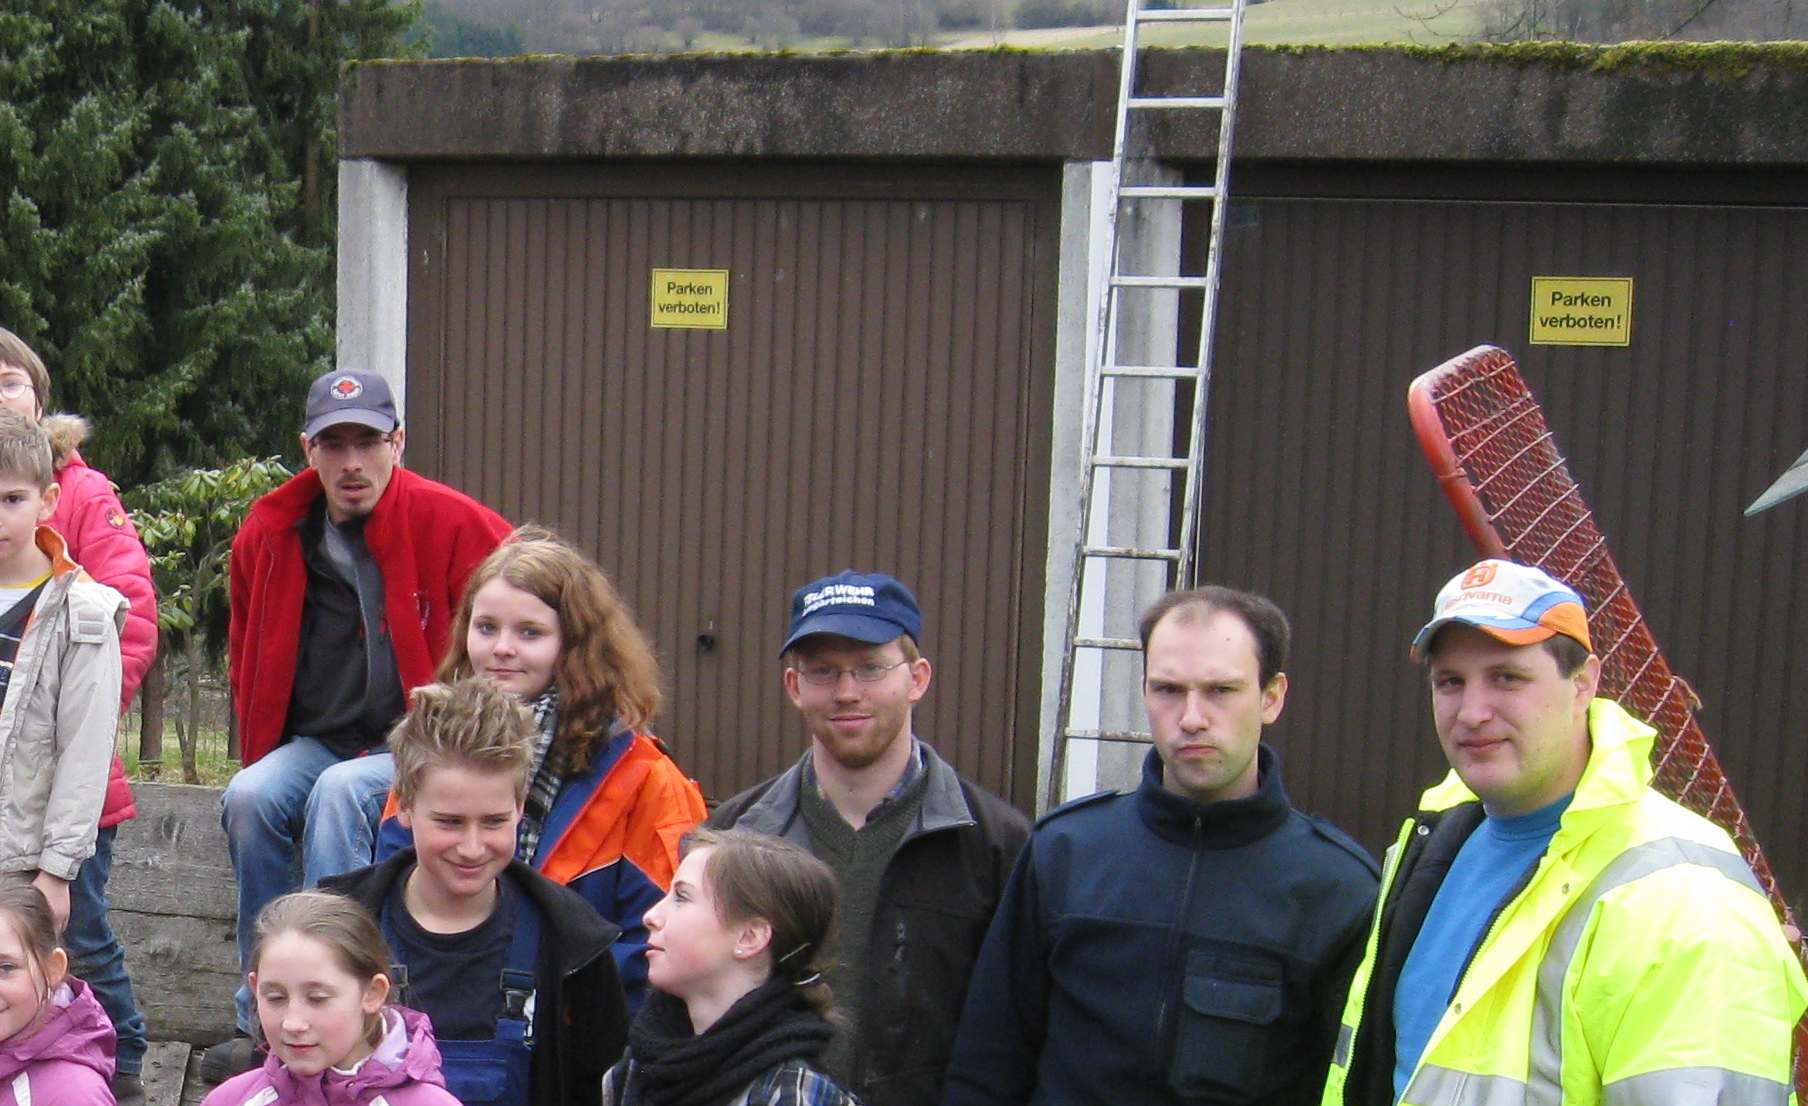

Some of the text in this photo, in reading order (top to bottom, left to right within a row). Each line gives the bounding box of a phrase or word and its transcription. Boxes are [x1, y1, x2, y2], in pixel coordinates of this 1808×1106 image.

[666, 280, 713, 296] Parken
[1551, 290, 1612, 308] Parken
[658, 300, 721, 315] verboten!
[1539, 313, 1622, 329] verboten!
